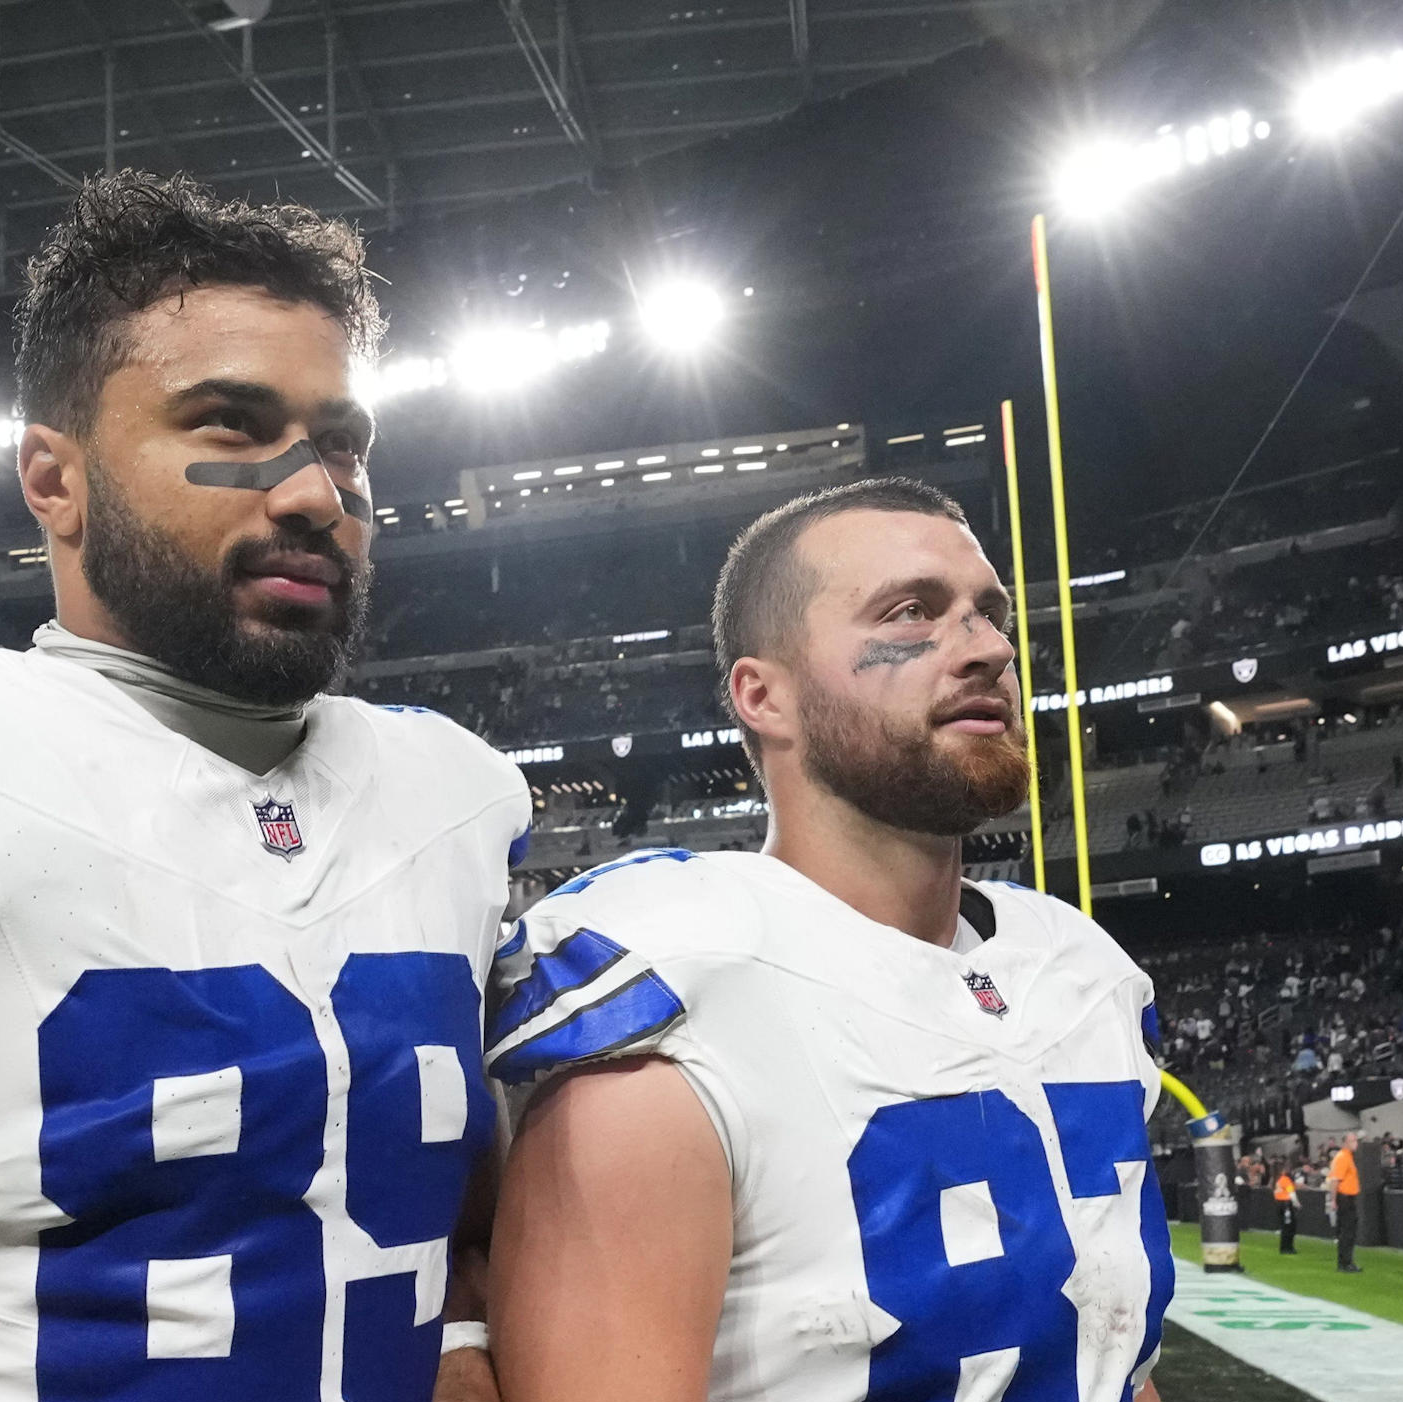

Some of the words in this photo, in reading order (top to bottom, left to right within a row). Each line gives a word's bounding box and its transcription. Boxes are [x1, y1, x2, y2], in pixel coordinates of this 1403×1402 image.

[1327, 639, 1367, 663] LAS
[1089, 675, 1174, 704] RAIDERS
[681, 730, 714, 748] LAS
[264, 822, 300, 848] NFL
[1266, 829, 1341, 856] VEGAS
